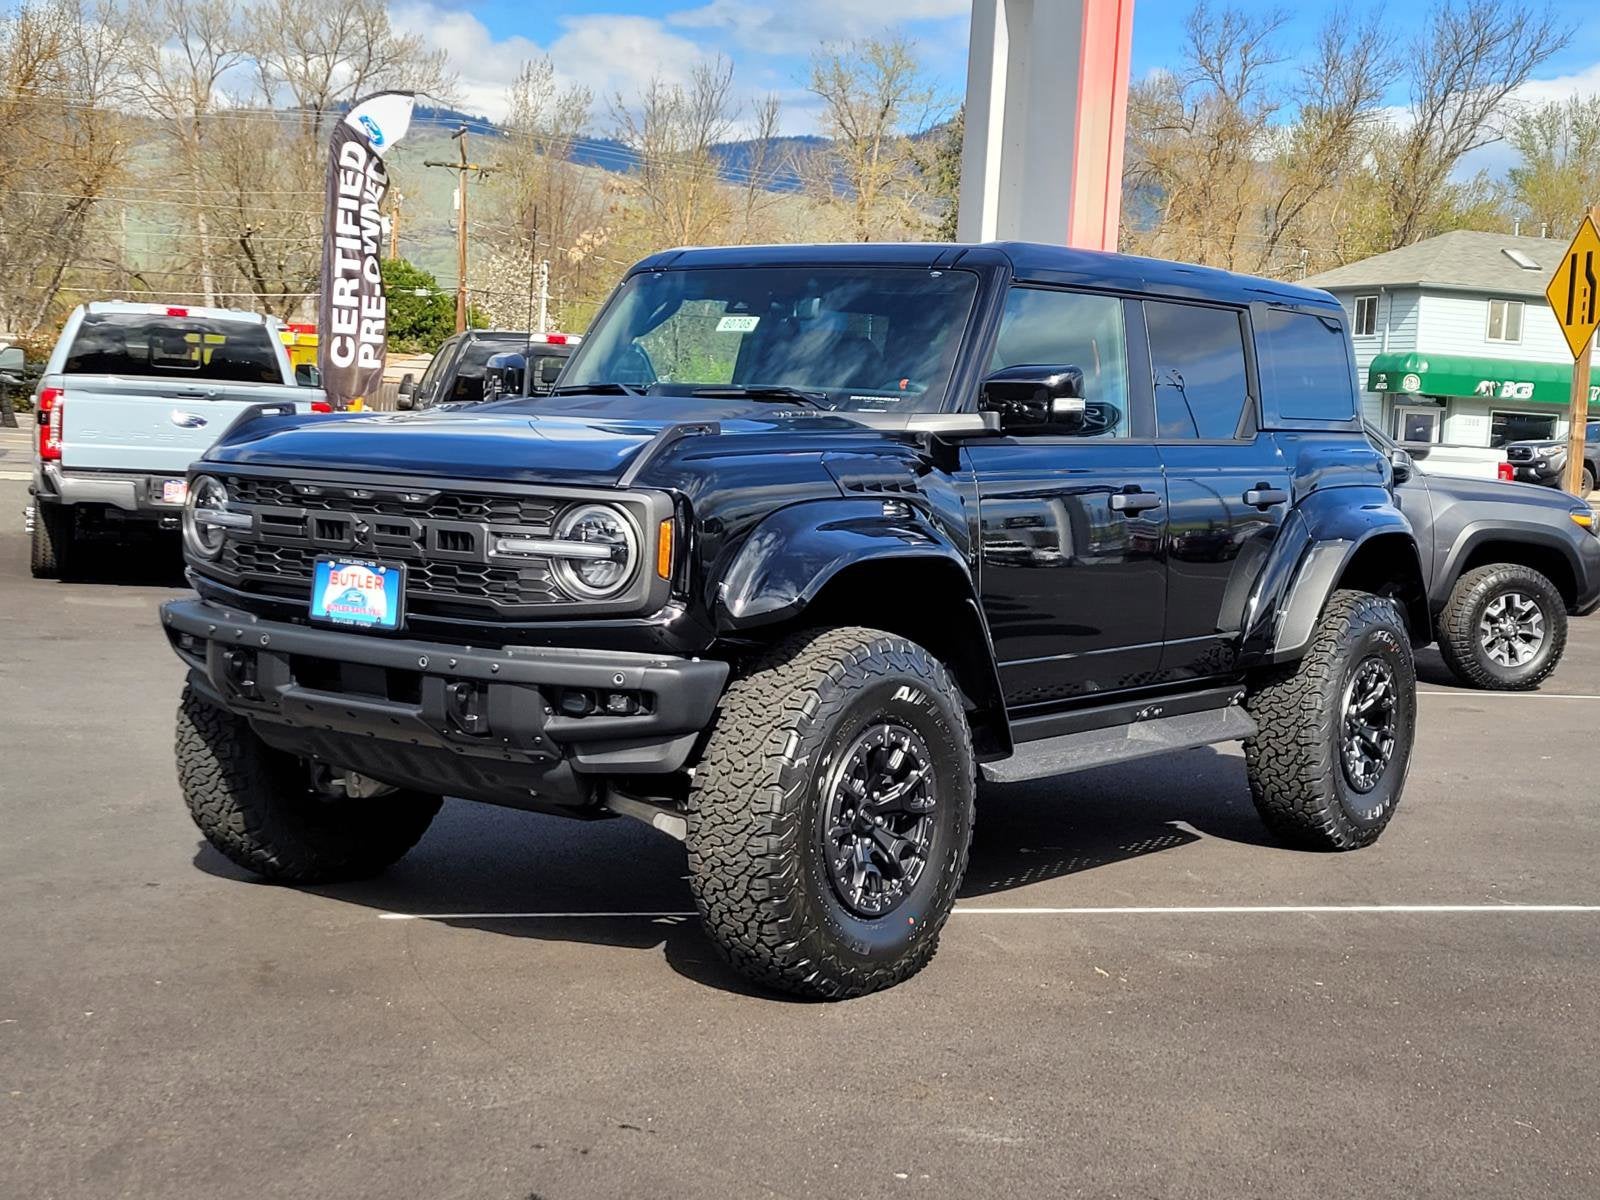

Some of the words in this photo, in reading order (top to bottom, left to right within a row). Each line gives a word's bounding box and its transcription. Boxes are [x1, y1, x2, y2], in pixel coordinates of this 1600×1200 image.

[330, 141, 367, 368] CERTIFIED
[358, 156, 389, 370] PRE-OWNED
[1500, 381, 1535, 399] BCB
[330, 570, 384, 590] BUTLER
